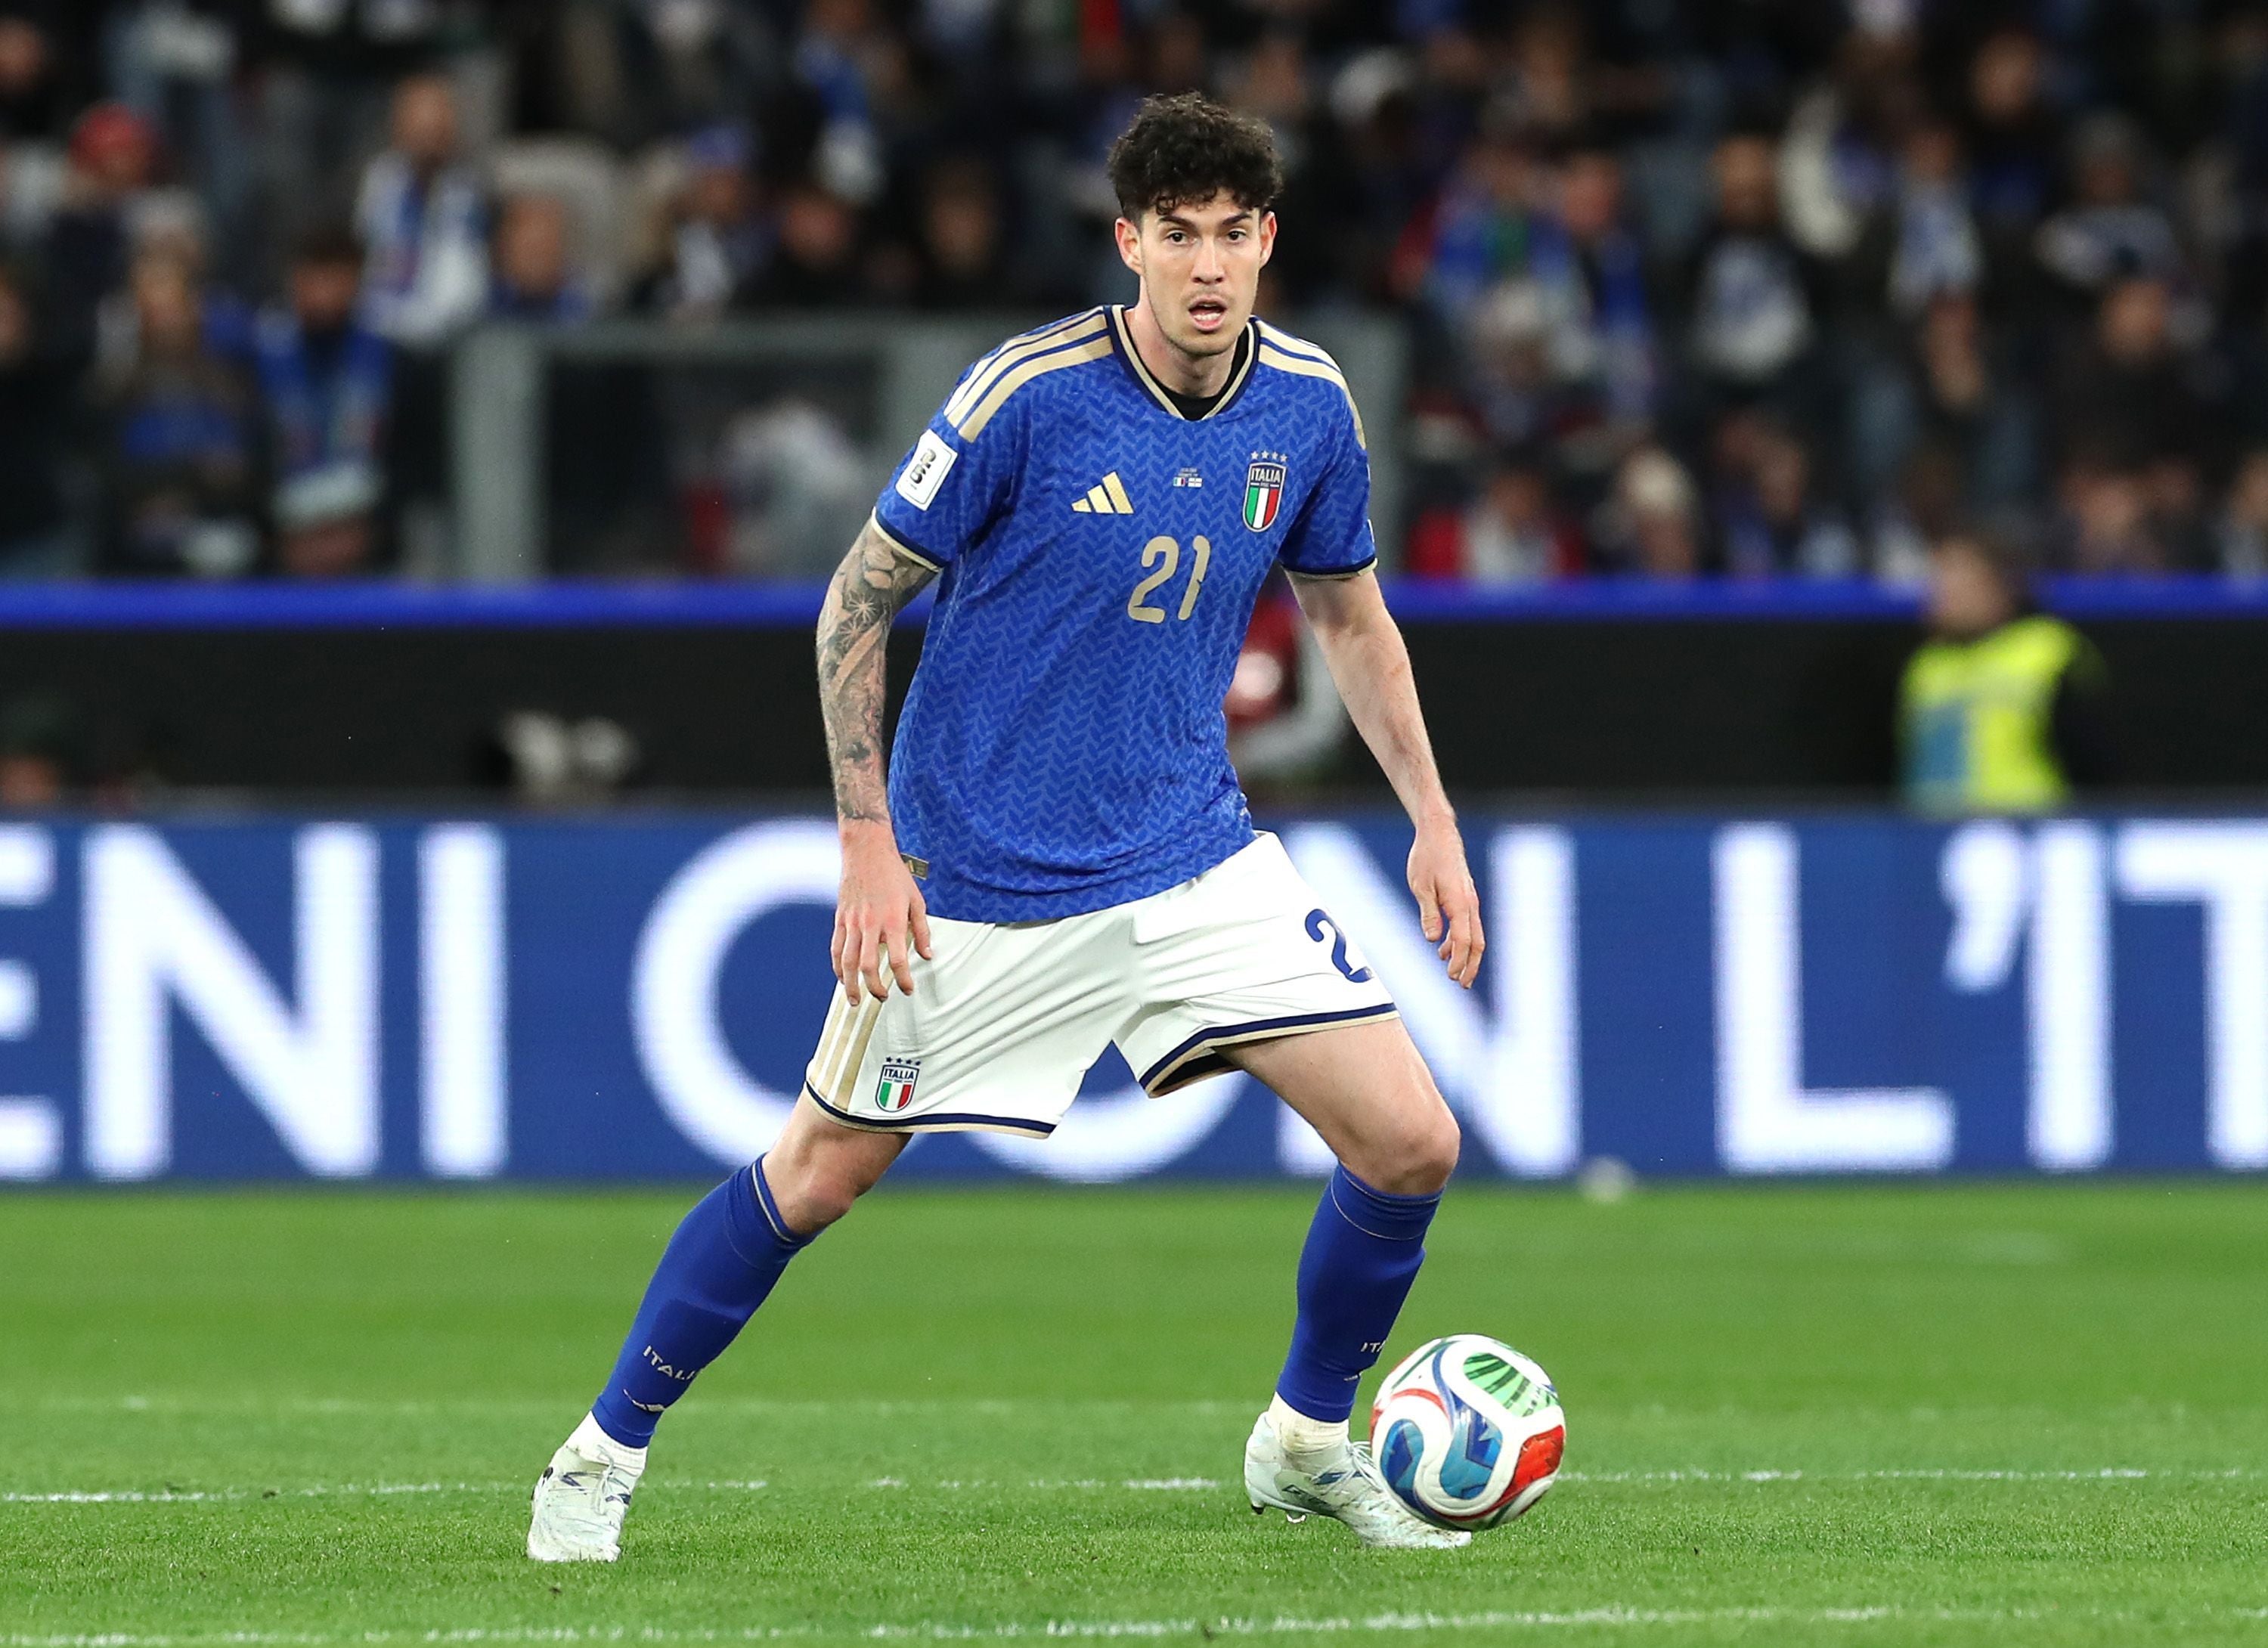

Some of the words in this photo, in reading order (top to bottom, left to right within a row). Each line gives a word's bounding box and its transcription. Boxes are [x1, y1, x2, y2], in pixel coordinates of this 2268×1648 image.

[1250, 466, 1281, 483] ITALIA
[1126, 534, 1211, 624] 21
[0, 821, 510, 1182] NI
[628, 816, 1584, 1182] CN
[883, 1068, 915, 1080] ITALIA
